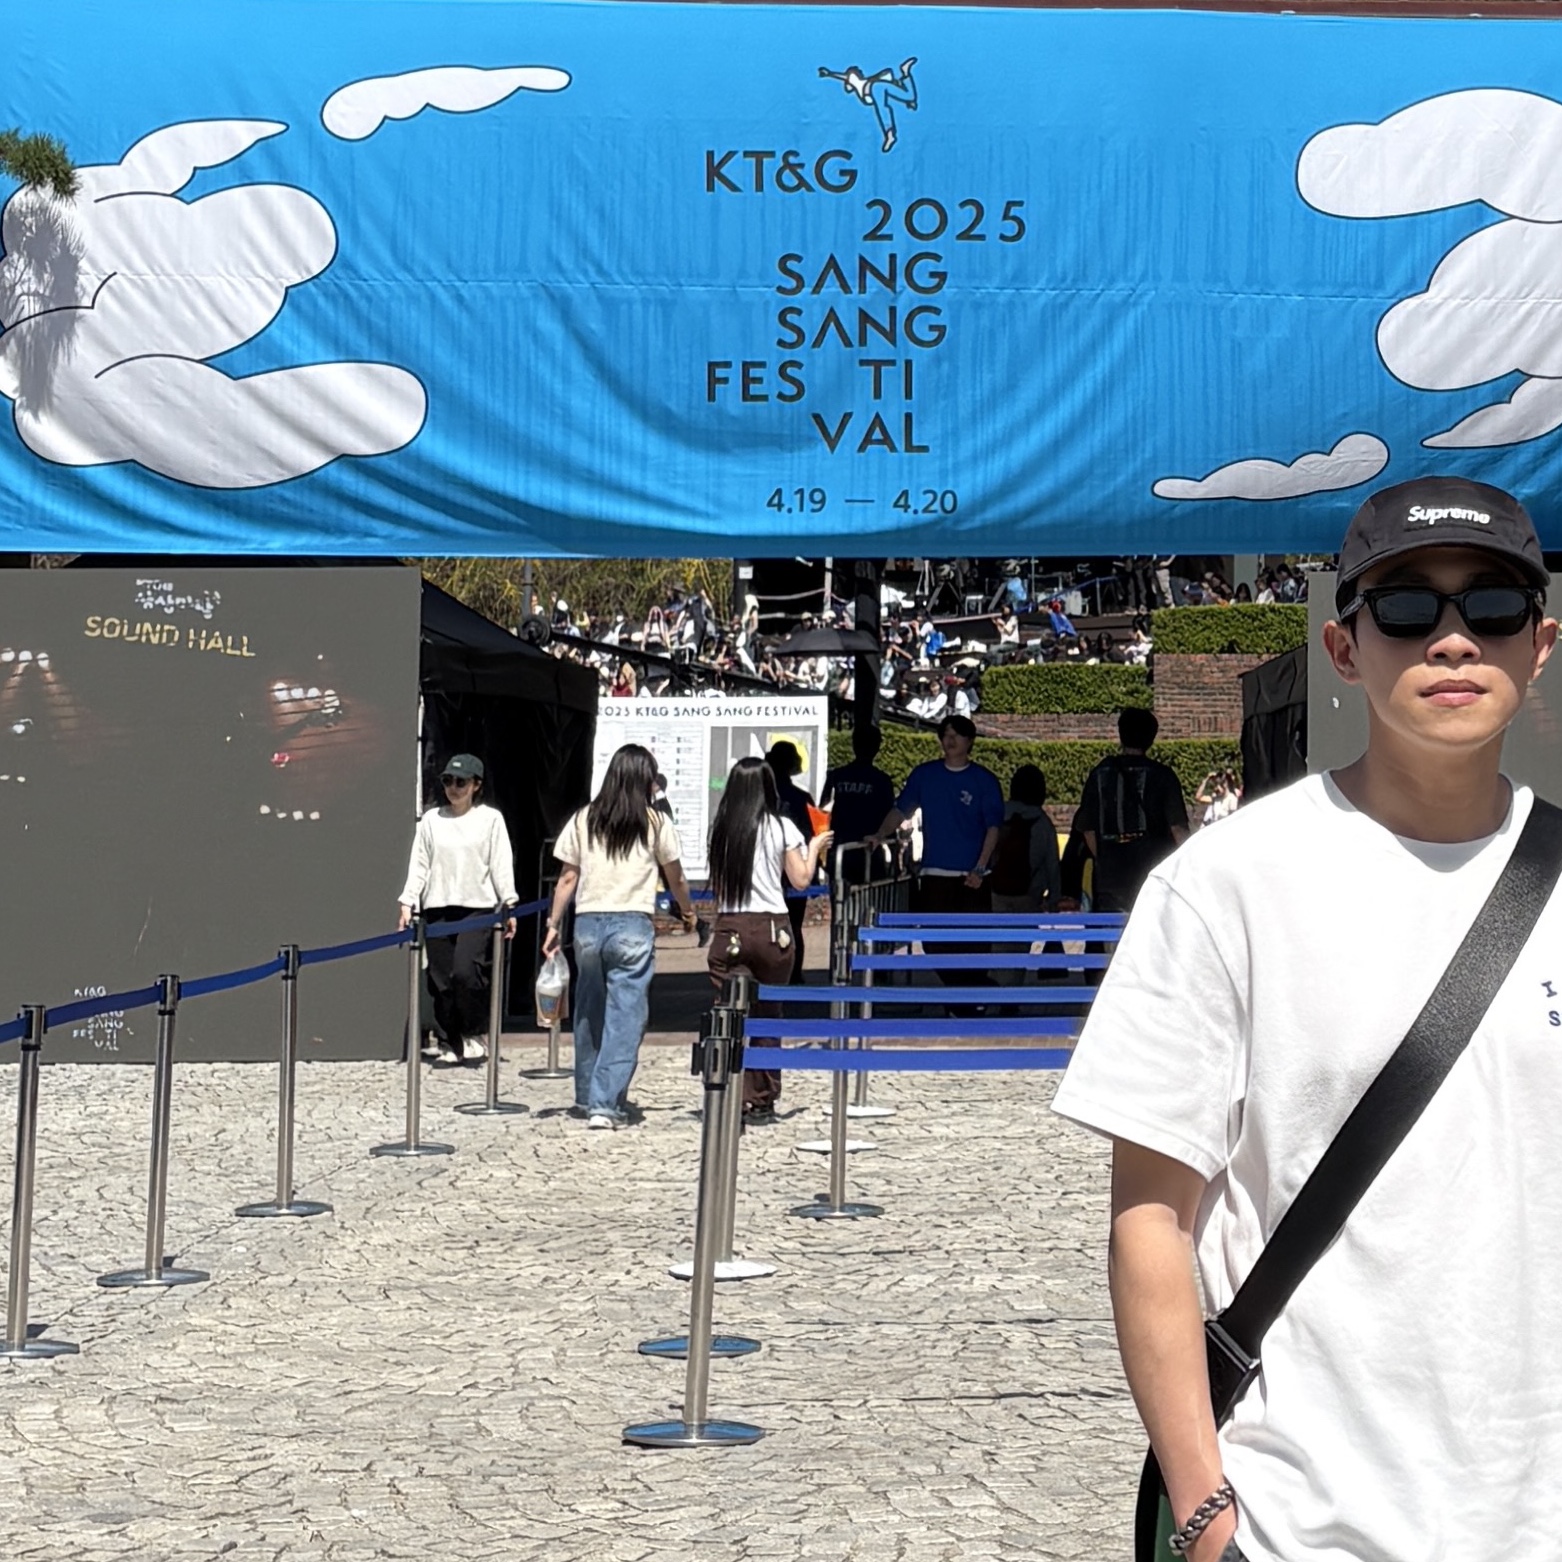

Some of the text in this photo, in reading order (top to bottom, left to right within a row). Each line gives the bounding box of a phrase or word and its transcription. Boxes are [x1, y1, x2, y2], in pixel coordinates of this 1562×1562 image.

[706, 150, 858, 193] KT&G
[863, 198, 1027, 243] 2025
[776, 252, 948, 295] SANG
[776, 305, 948, 350] SANG
[707, 359, 913, 402] FES TI
[811, 412, 930, 455] VAL
[766, 487, 827, 514] 4.19
[892, 489, 958, 515] 4.20
[1407, 506, 1491, 525] Supreme
[84, 616, 257, 657] SOUND HALL
[673, 706, 711, 717] SANG
[715, 706, 753, 717] SANG
[757, 705, 819, 717] FESTIVAL
